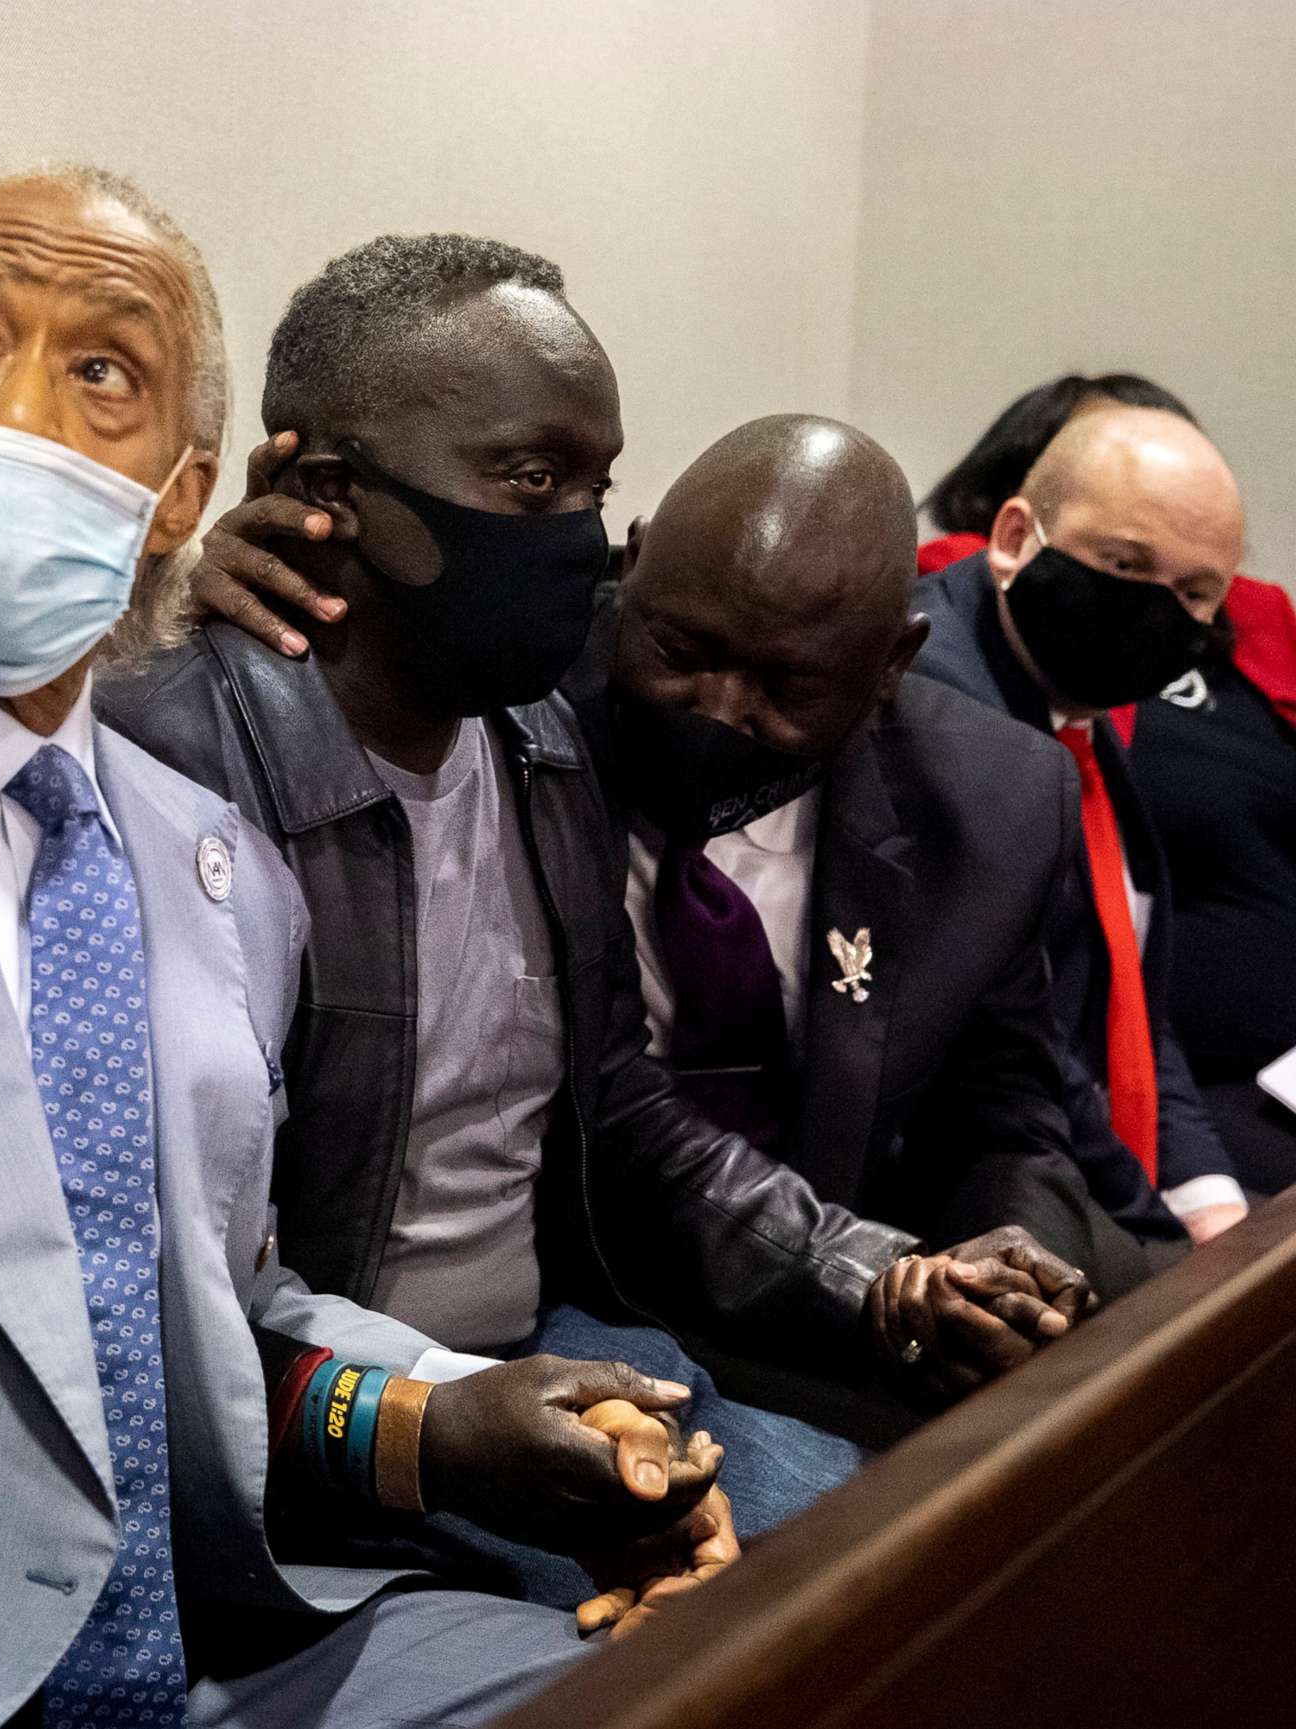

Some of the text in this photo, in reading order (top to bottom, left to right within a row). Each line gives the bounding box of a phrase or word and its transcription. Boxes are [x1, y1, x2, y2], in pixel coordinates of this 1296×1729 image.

[708, 792, 748, 821] BEN
[328, 1368, 360, 1438] JUDE 1:20
